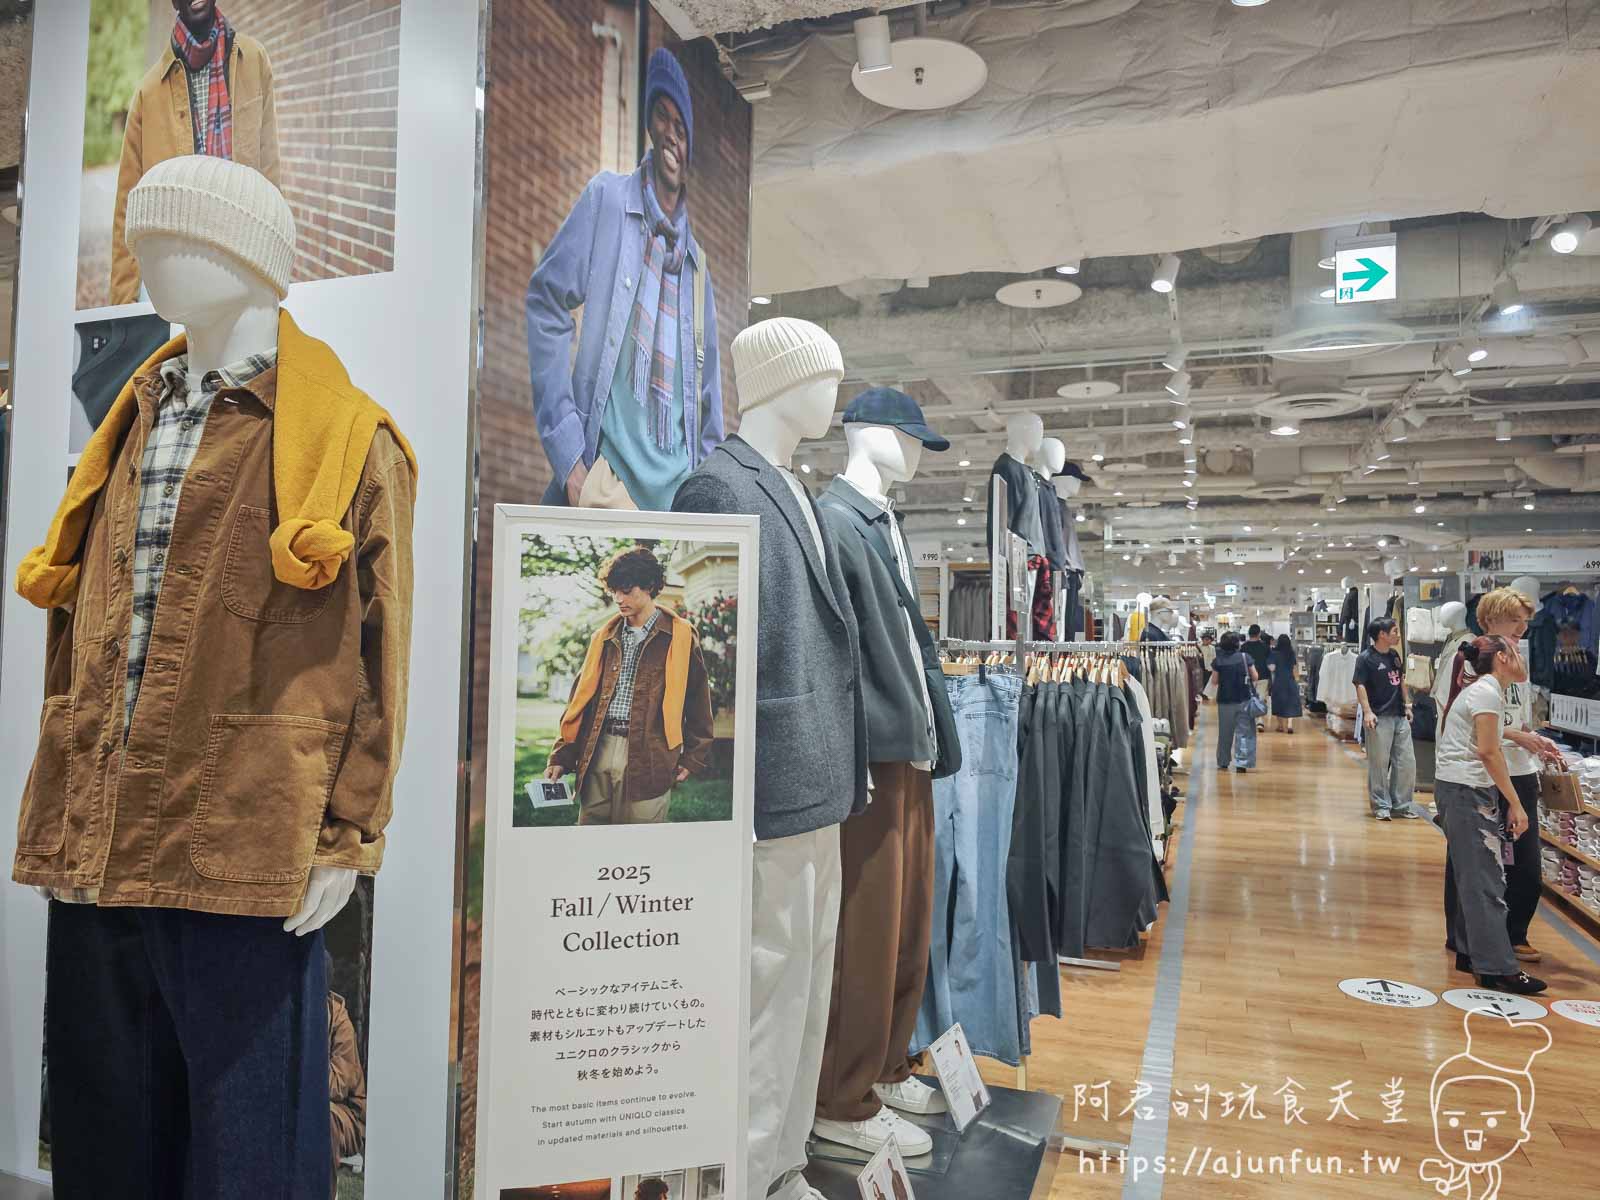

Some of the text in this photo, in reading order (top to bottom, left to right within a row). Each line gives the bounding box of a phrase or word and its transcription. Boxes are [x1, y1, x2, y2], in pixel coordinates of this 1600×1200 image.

[597, 865, 651, 885] 2025
[563, 928, 681, 952] Collection
[555, 978, 684, 996] ベーシックなアイテムこそ、
[531, 998, 706, 1021] 時代とともに変わり続けていくもの。
[529, 1018, 706, 1042] 素材もシルエットもアップデートした
[555, 1040, 681, 1061] ユニクロのクラシックから
[576, 1063, 660, 1081] 秋冬を始めよう。
[531, 1105, 547, 1113] The
[548, 1103, 569, 1112] most
[571, 1101, 594, 1110] basic
[596, 1099, 618, 1107] items
[620, 1095, 656, 1105] continue
[669, 1090, 697, 1100] evolve.
[542, 1107, 685, 1129] Start autumn with UNIQLO classics
[547, 1134, 583, 1146] updated
[585, 1129, 623, 1140] materials
[625, 1127, 641, 1136] and
[642, 1123, 689, 1135] silhouettes.
